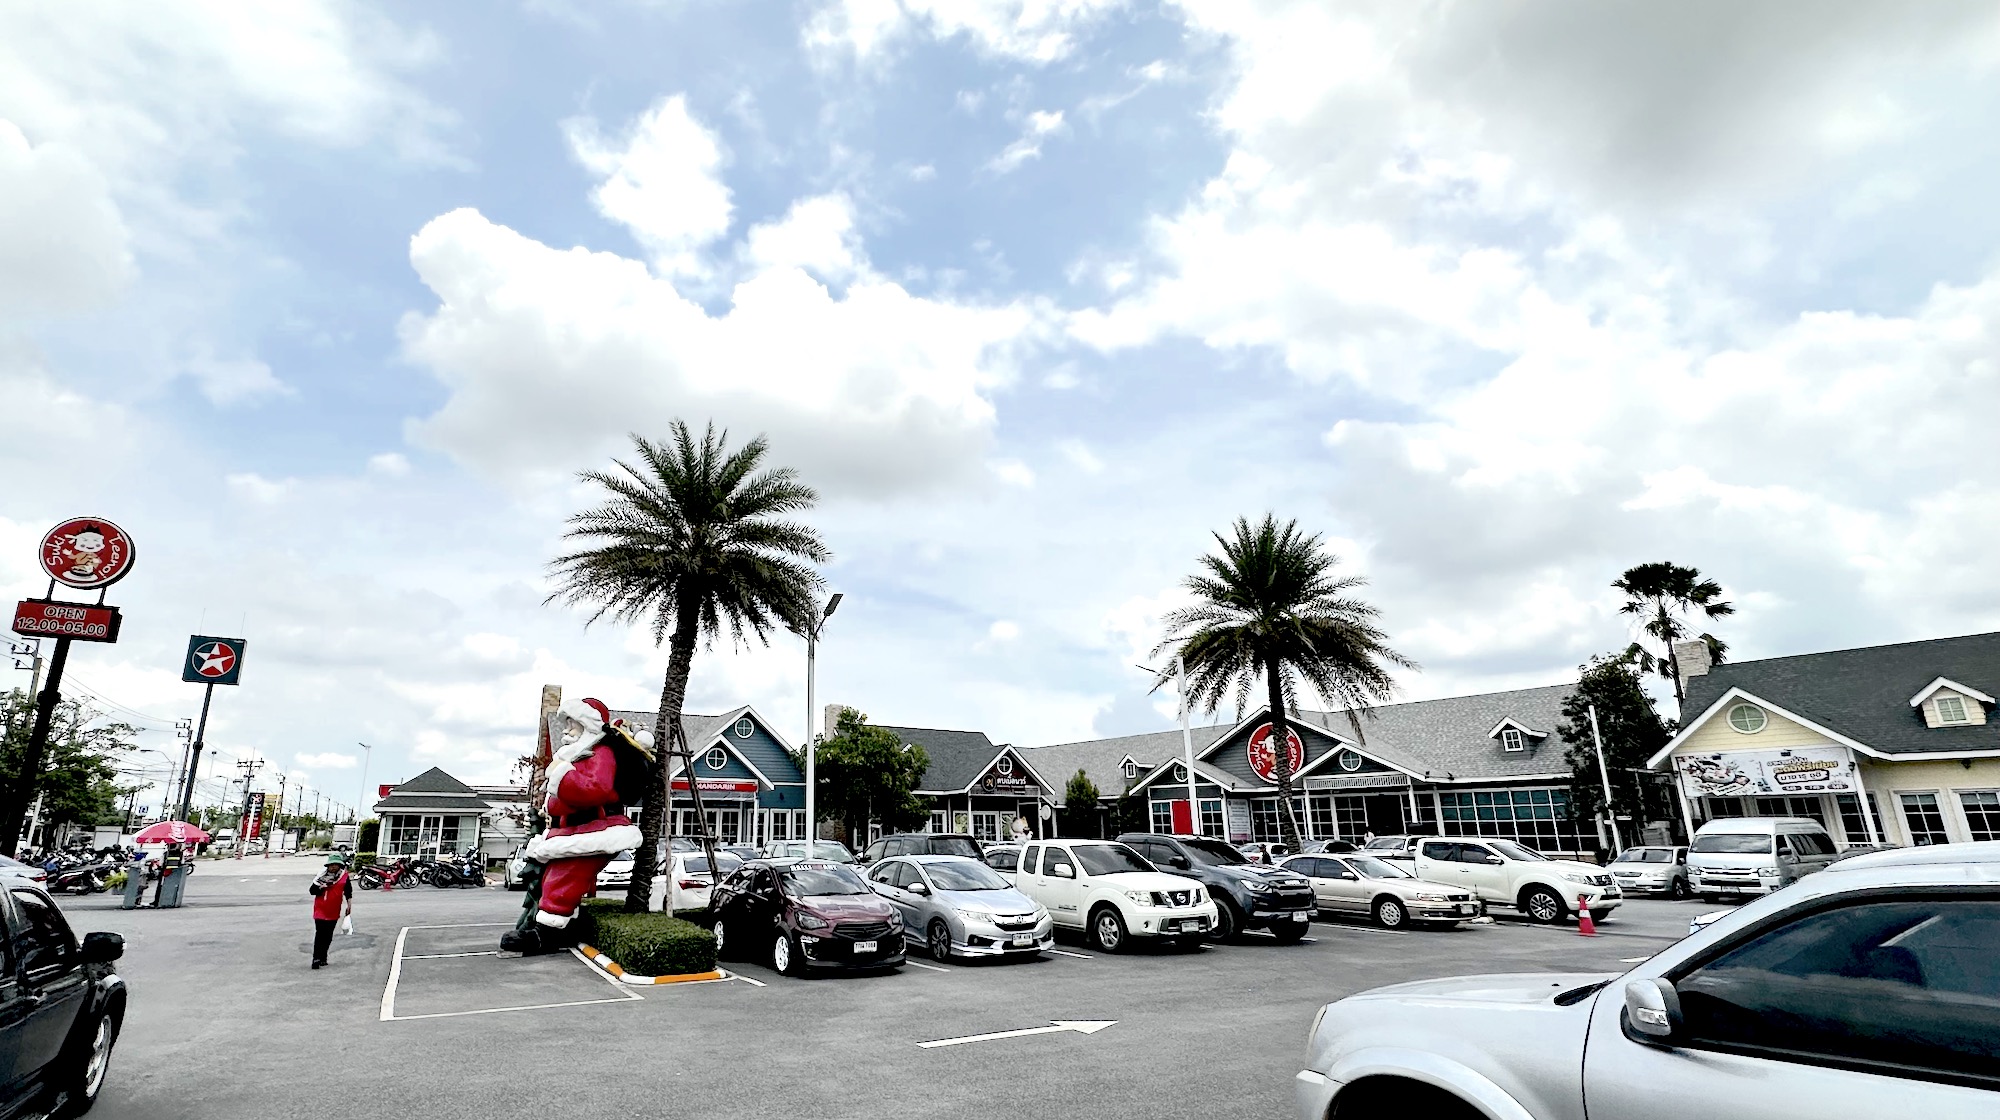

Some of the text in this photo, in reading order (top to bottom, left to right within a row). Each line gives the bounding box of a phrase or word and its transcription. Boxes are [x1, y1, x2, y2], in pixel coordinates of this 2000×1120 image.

[46, 535, 66, 566] Suki
[44, 606, 86, 620] OPEN
[17, 617, 106, 636] 12.00-05.00
